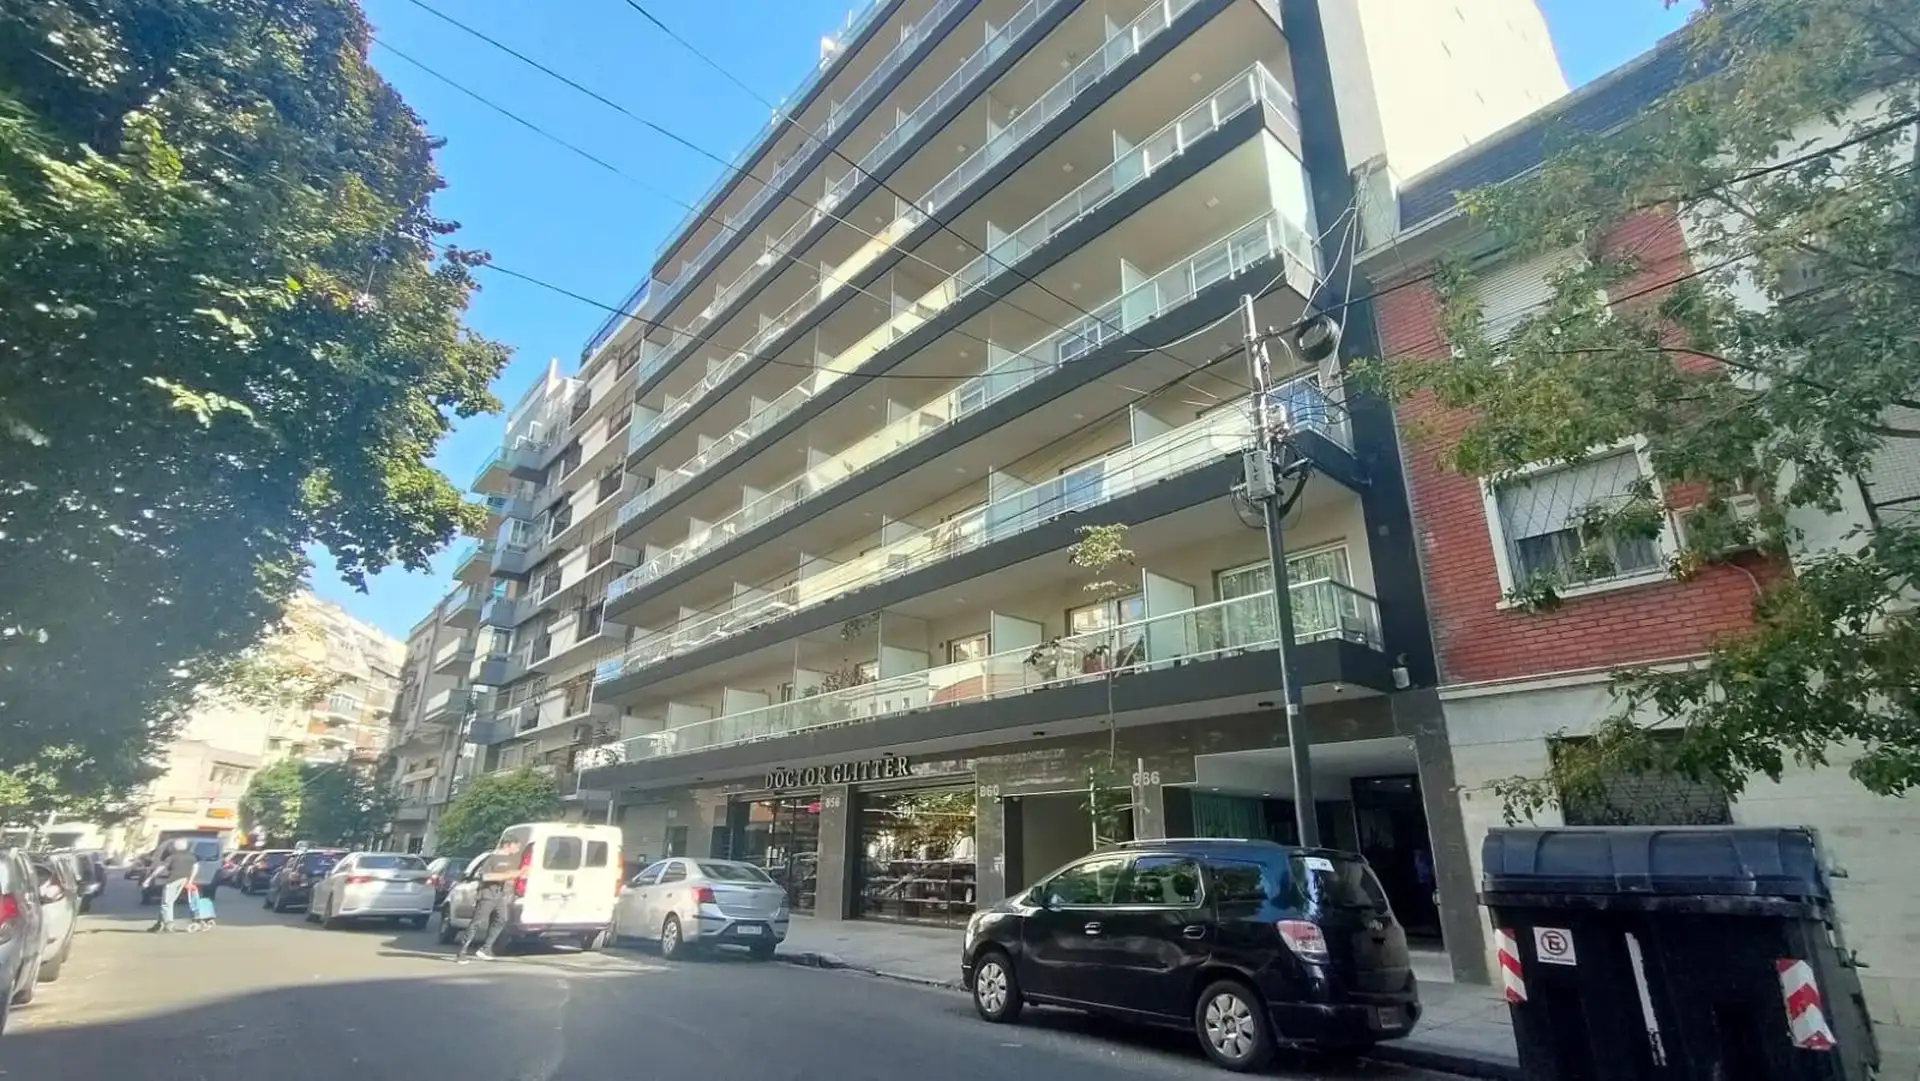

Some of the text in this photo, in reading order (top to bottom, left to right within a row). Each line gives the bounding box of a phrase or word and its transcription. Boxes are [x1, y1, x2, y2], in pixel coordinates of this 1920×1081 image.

[765, 756, 909, 789] DOCTOR GLITTER
[1132, 771, 1160, 787] 866
